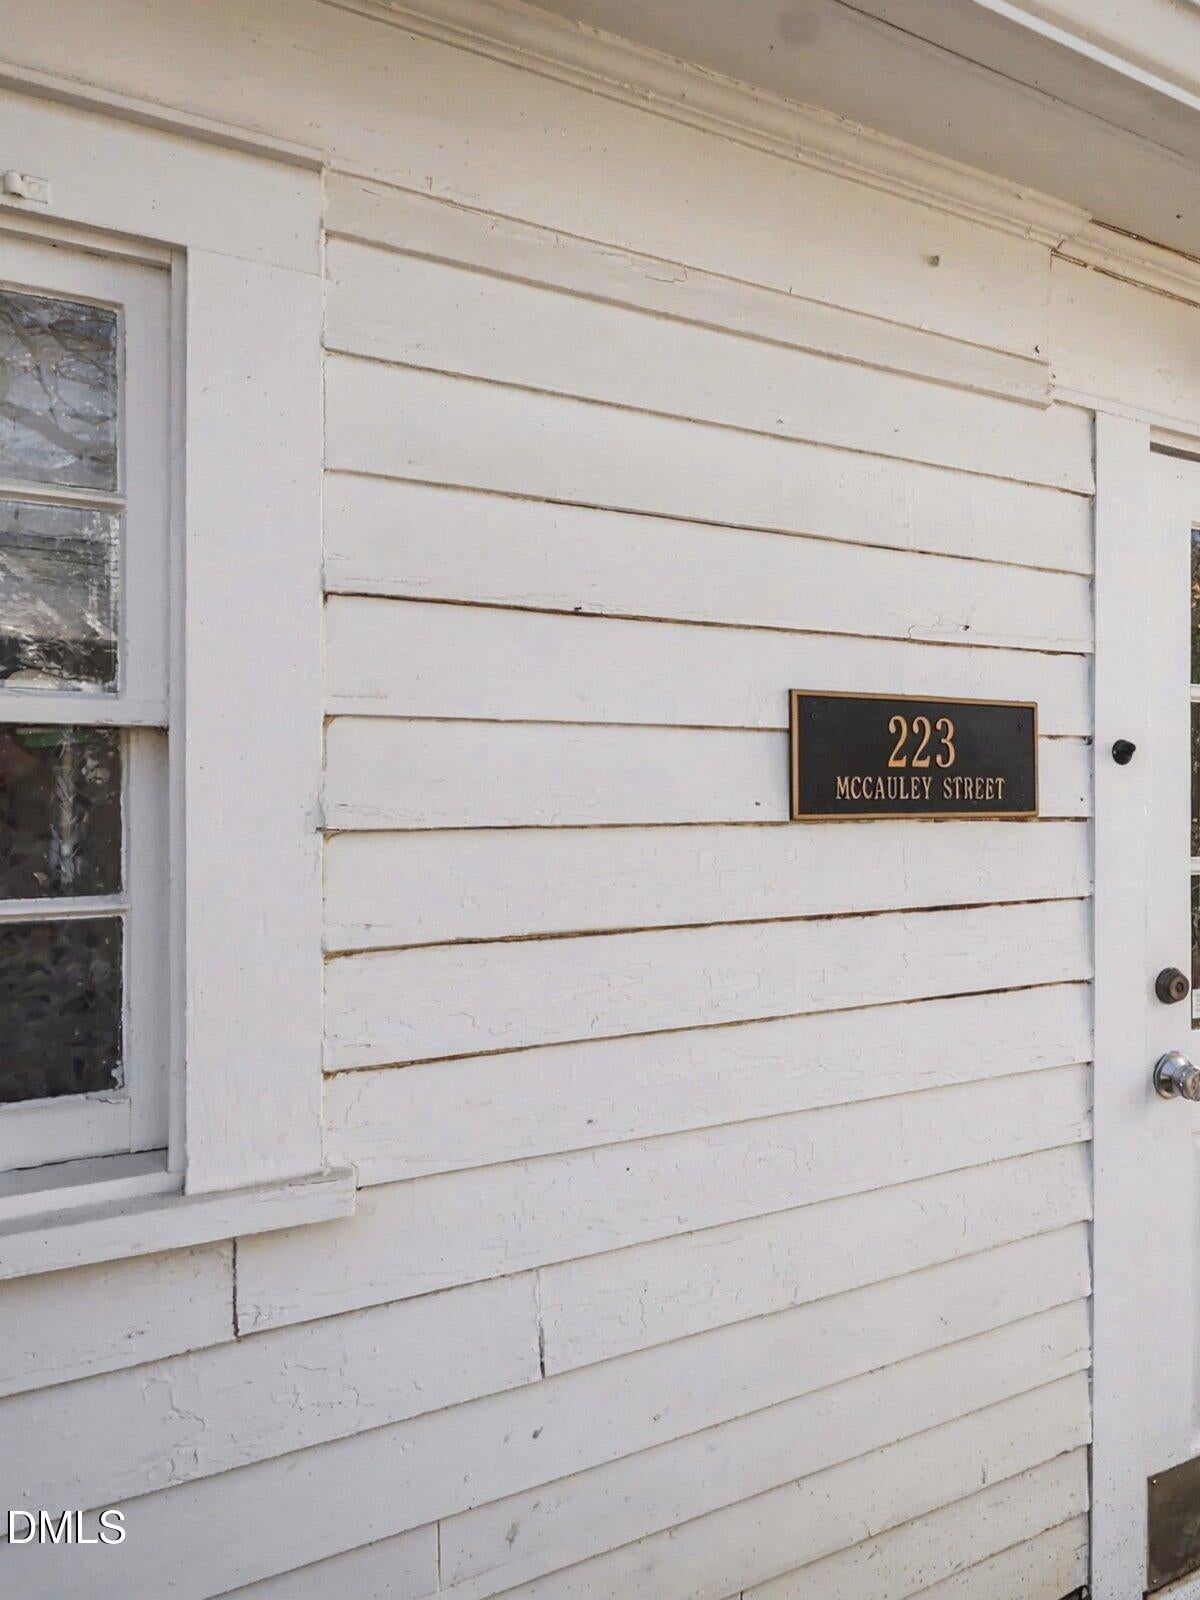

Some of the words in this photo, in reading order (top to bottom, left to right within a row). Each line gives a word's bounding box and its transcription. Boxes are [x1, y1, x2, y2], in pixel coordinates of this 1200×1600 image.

[888, 715, 956, 768] 223
[836, 776, 932, 800] MCCAULEY
[943, 777, 1005, 800] STREET
